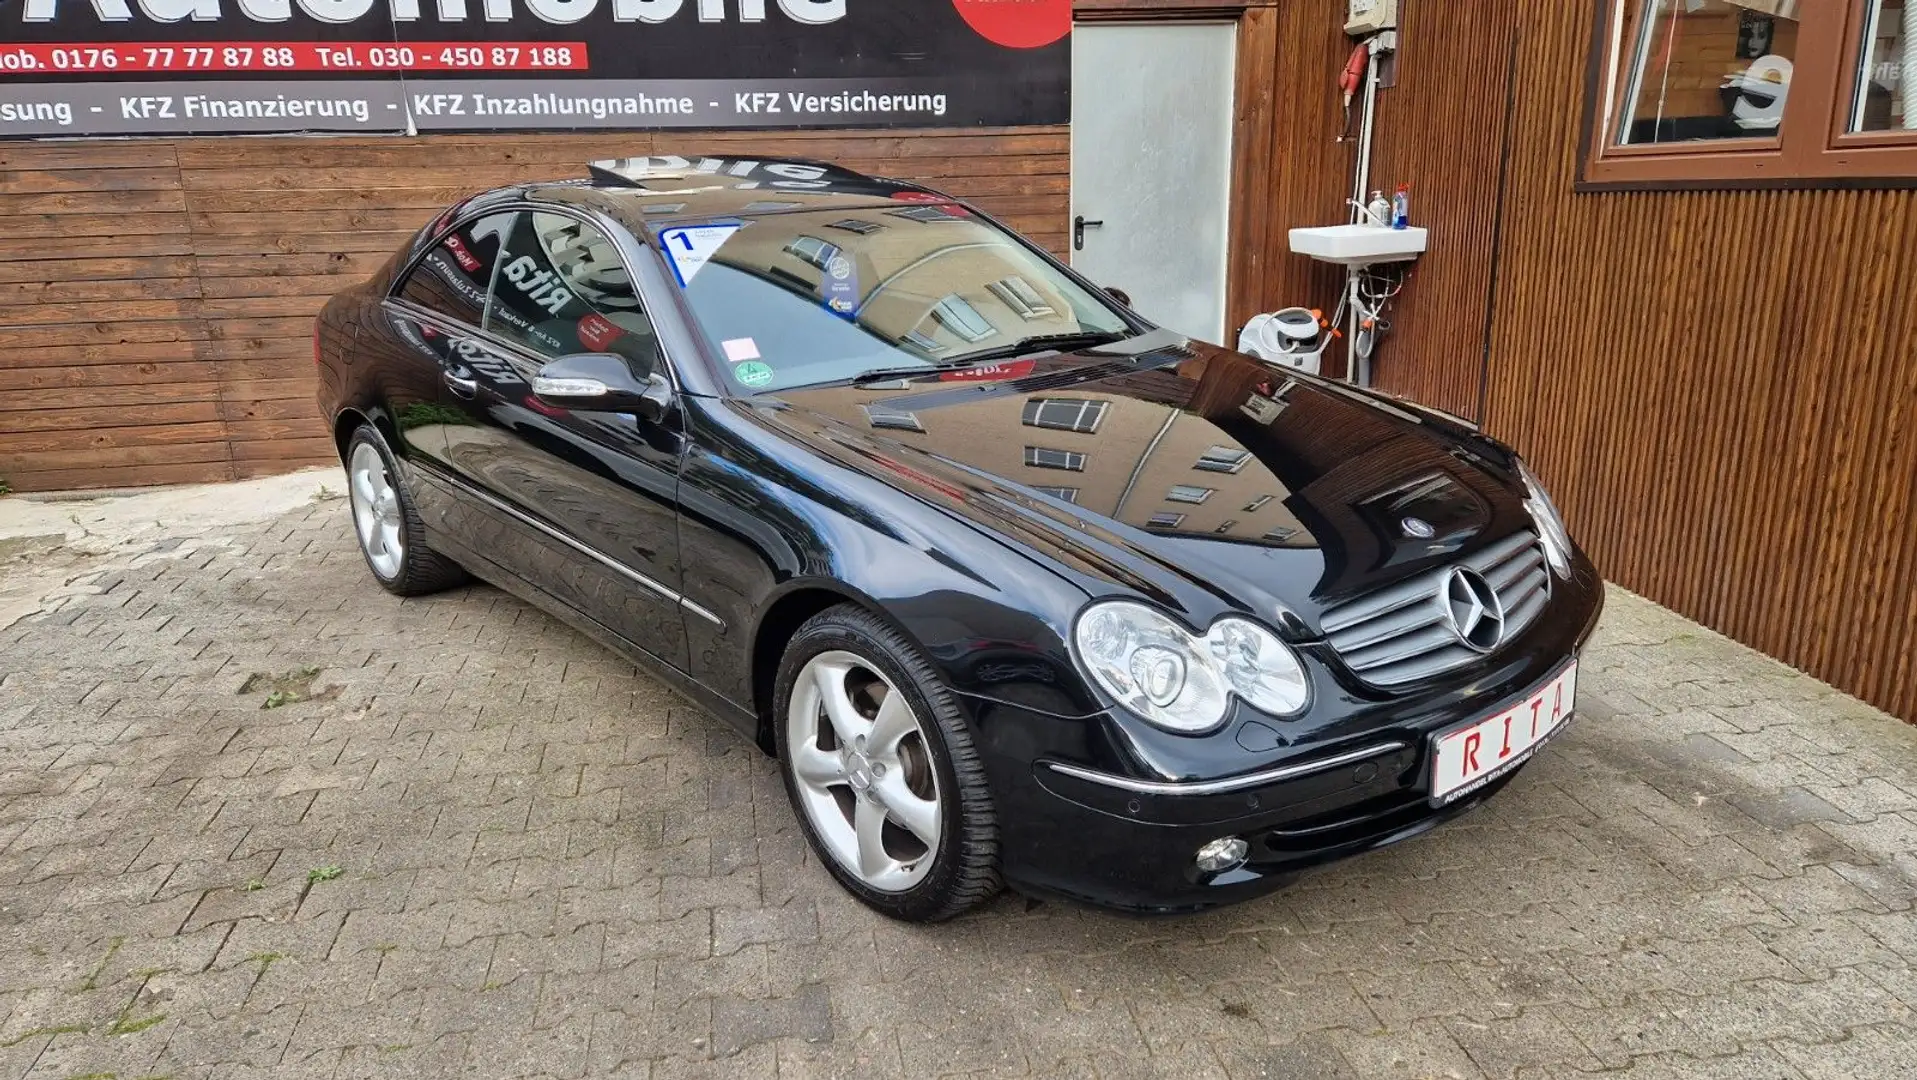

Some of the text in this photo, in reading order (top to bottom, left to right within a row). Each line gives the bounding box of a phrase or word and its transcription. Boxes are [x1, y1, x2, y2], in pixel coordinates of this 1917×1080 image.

[0, 49, 45, 69] ob.
[51, 48, 118, 69] 0176
[143, 47, 174, 67] 77
[183, 47, 214, 67] 77
[222, 47, 254, 67] 87
[262, 47, 295, 67] 88
[315, 47, 362, 67] Tel.
[368, 47, 415, 67] 030
[439, 47, 484, 67] 450
[491, 47, 520, 67] 87
[530, 47, 572, 66] 188
[119, 96, 176, 119] KFZ
[183, 94, 369, 123] Finanzierung
[414, 94, 466, 116] KFZ
[472, 92, 694, 119] Inzahlungnahme
[735, 92, 781, 113] KFZ
[787, 90, 947, 115] Versicherung
